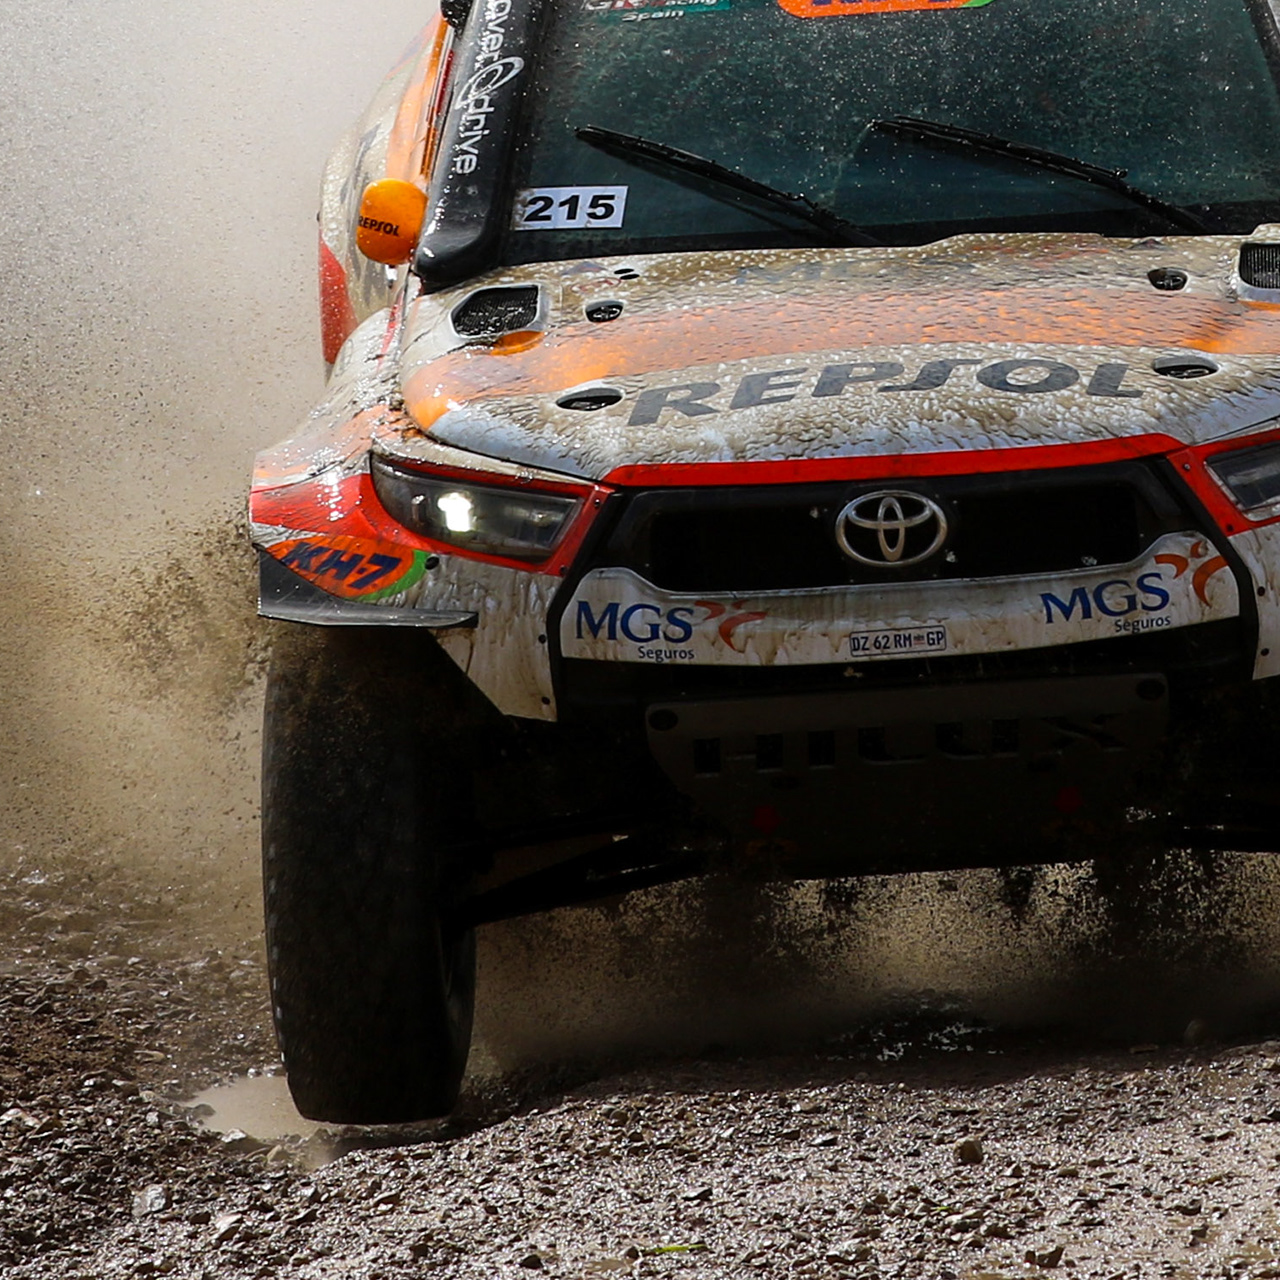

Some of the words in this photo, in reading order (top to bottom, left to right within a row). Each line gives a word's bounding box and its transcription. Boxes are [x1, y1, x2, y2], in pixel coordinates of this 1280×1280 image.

[622, 9, 685, 22] Spain
[454, 95, 496, 175] drive
[523, 194, 616, 222] 215
[627, 357, 1144, 426] REPSOL
[1040, 572, 1170, 624] MGS
[576, 600, 694, 644] MGS
[1114, 614, 1171, 634] Seguros
[637, 644, 696, 664] Seguros
[851, 636, 870, 652] DZ
[873, 634, 891, 650] 62
[893, 632, 913, 649] RM
[926, 630, 945, 647] GP
